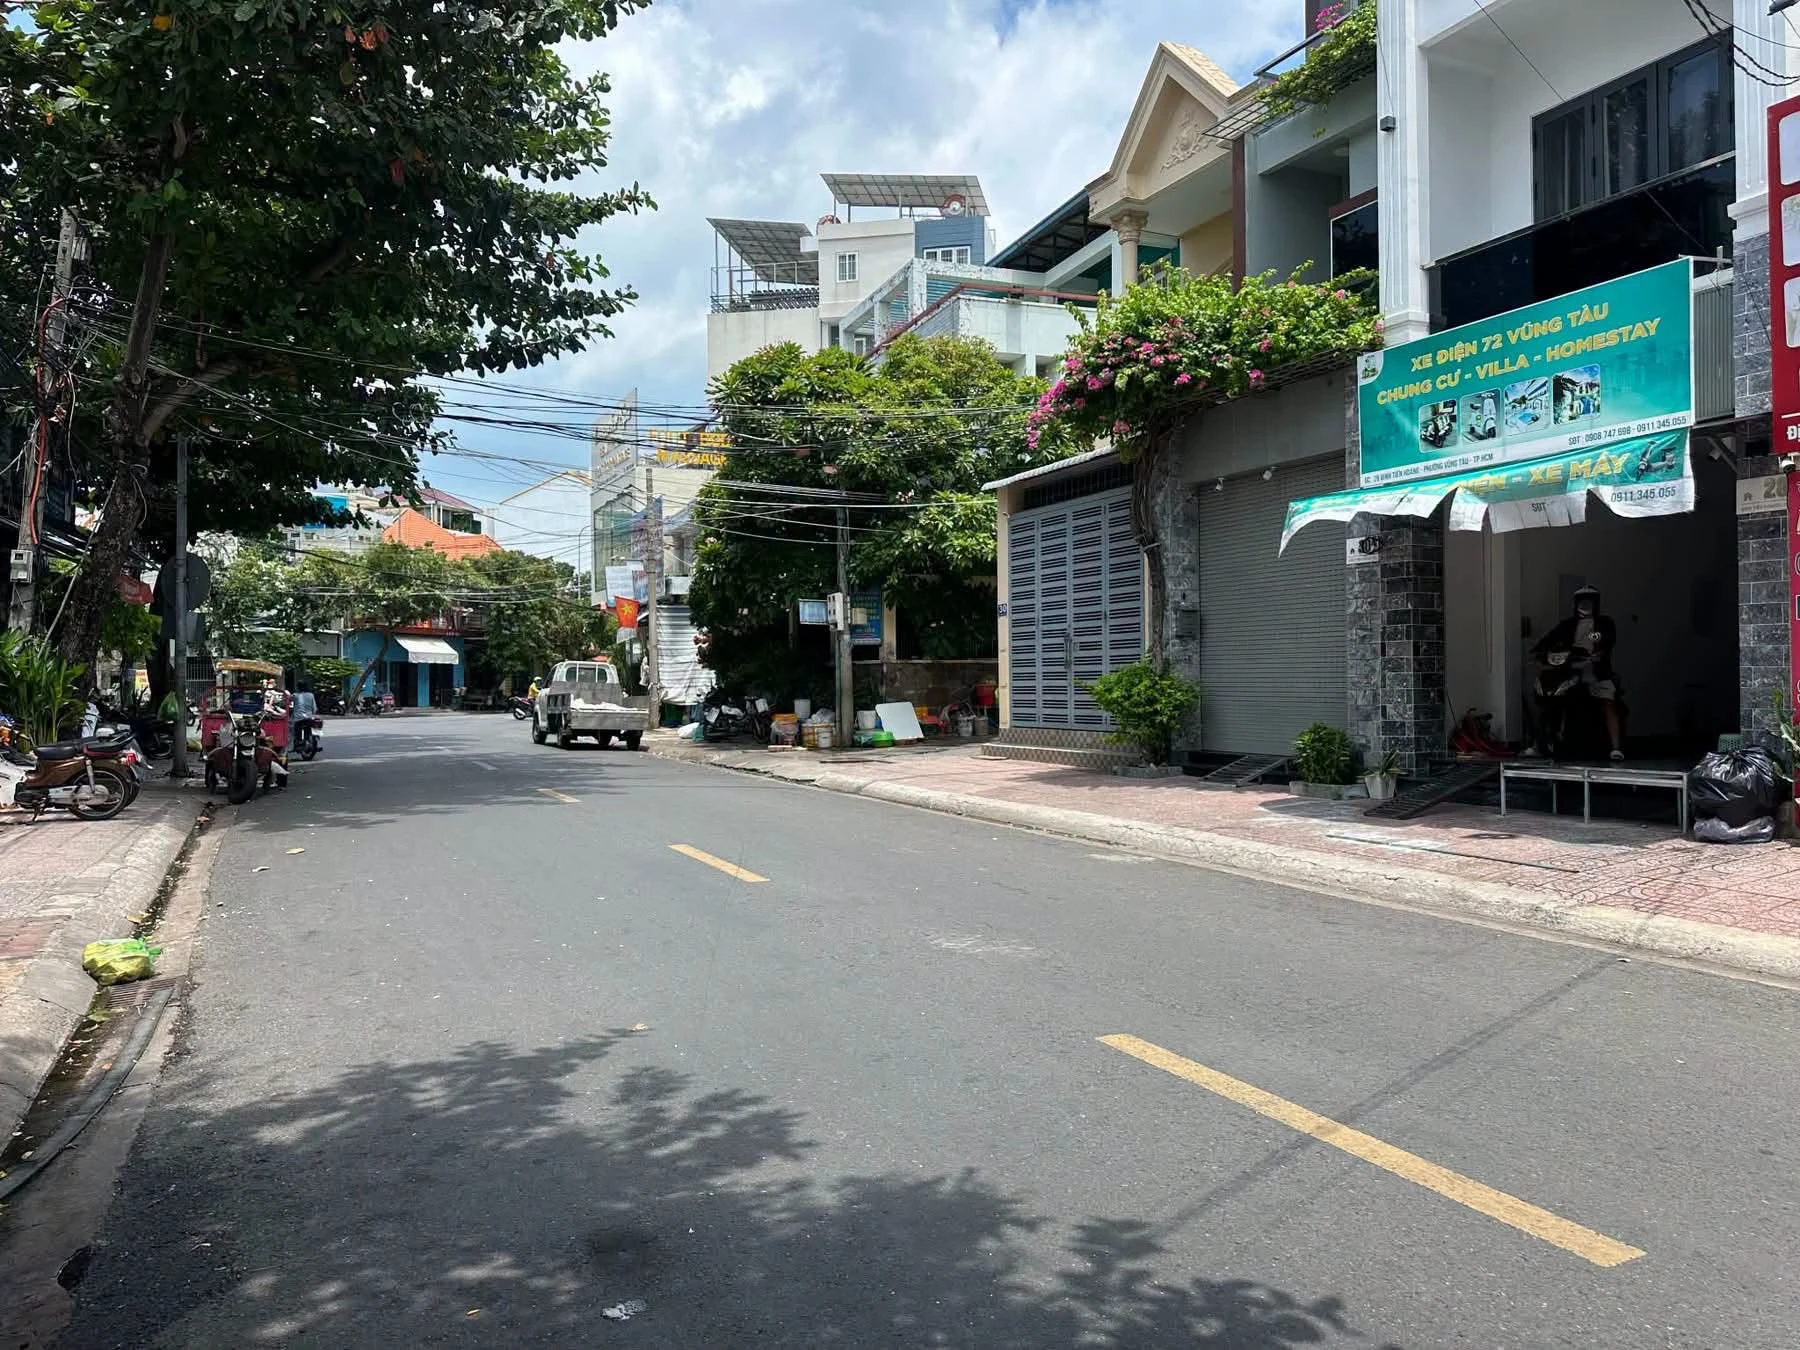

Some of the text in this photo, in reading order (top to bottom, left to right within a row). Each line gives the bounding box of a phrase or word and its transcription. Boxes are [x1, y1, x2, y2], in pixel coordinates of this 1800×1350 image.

[1377, 379, 1433, 405] CHUNG
[1436, 368, 1461, 390] CƯ
[1475, 353, 1529, 380] VILLA
[1546, 317, 1661, 362] HOMESTAY
[1411, 302, 1609, 372] XE ĐIỆN 72 VŨNG TÀU
[1528, 463, 1563, 486] XE
